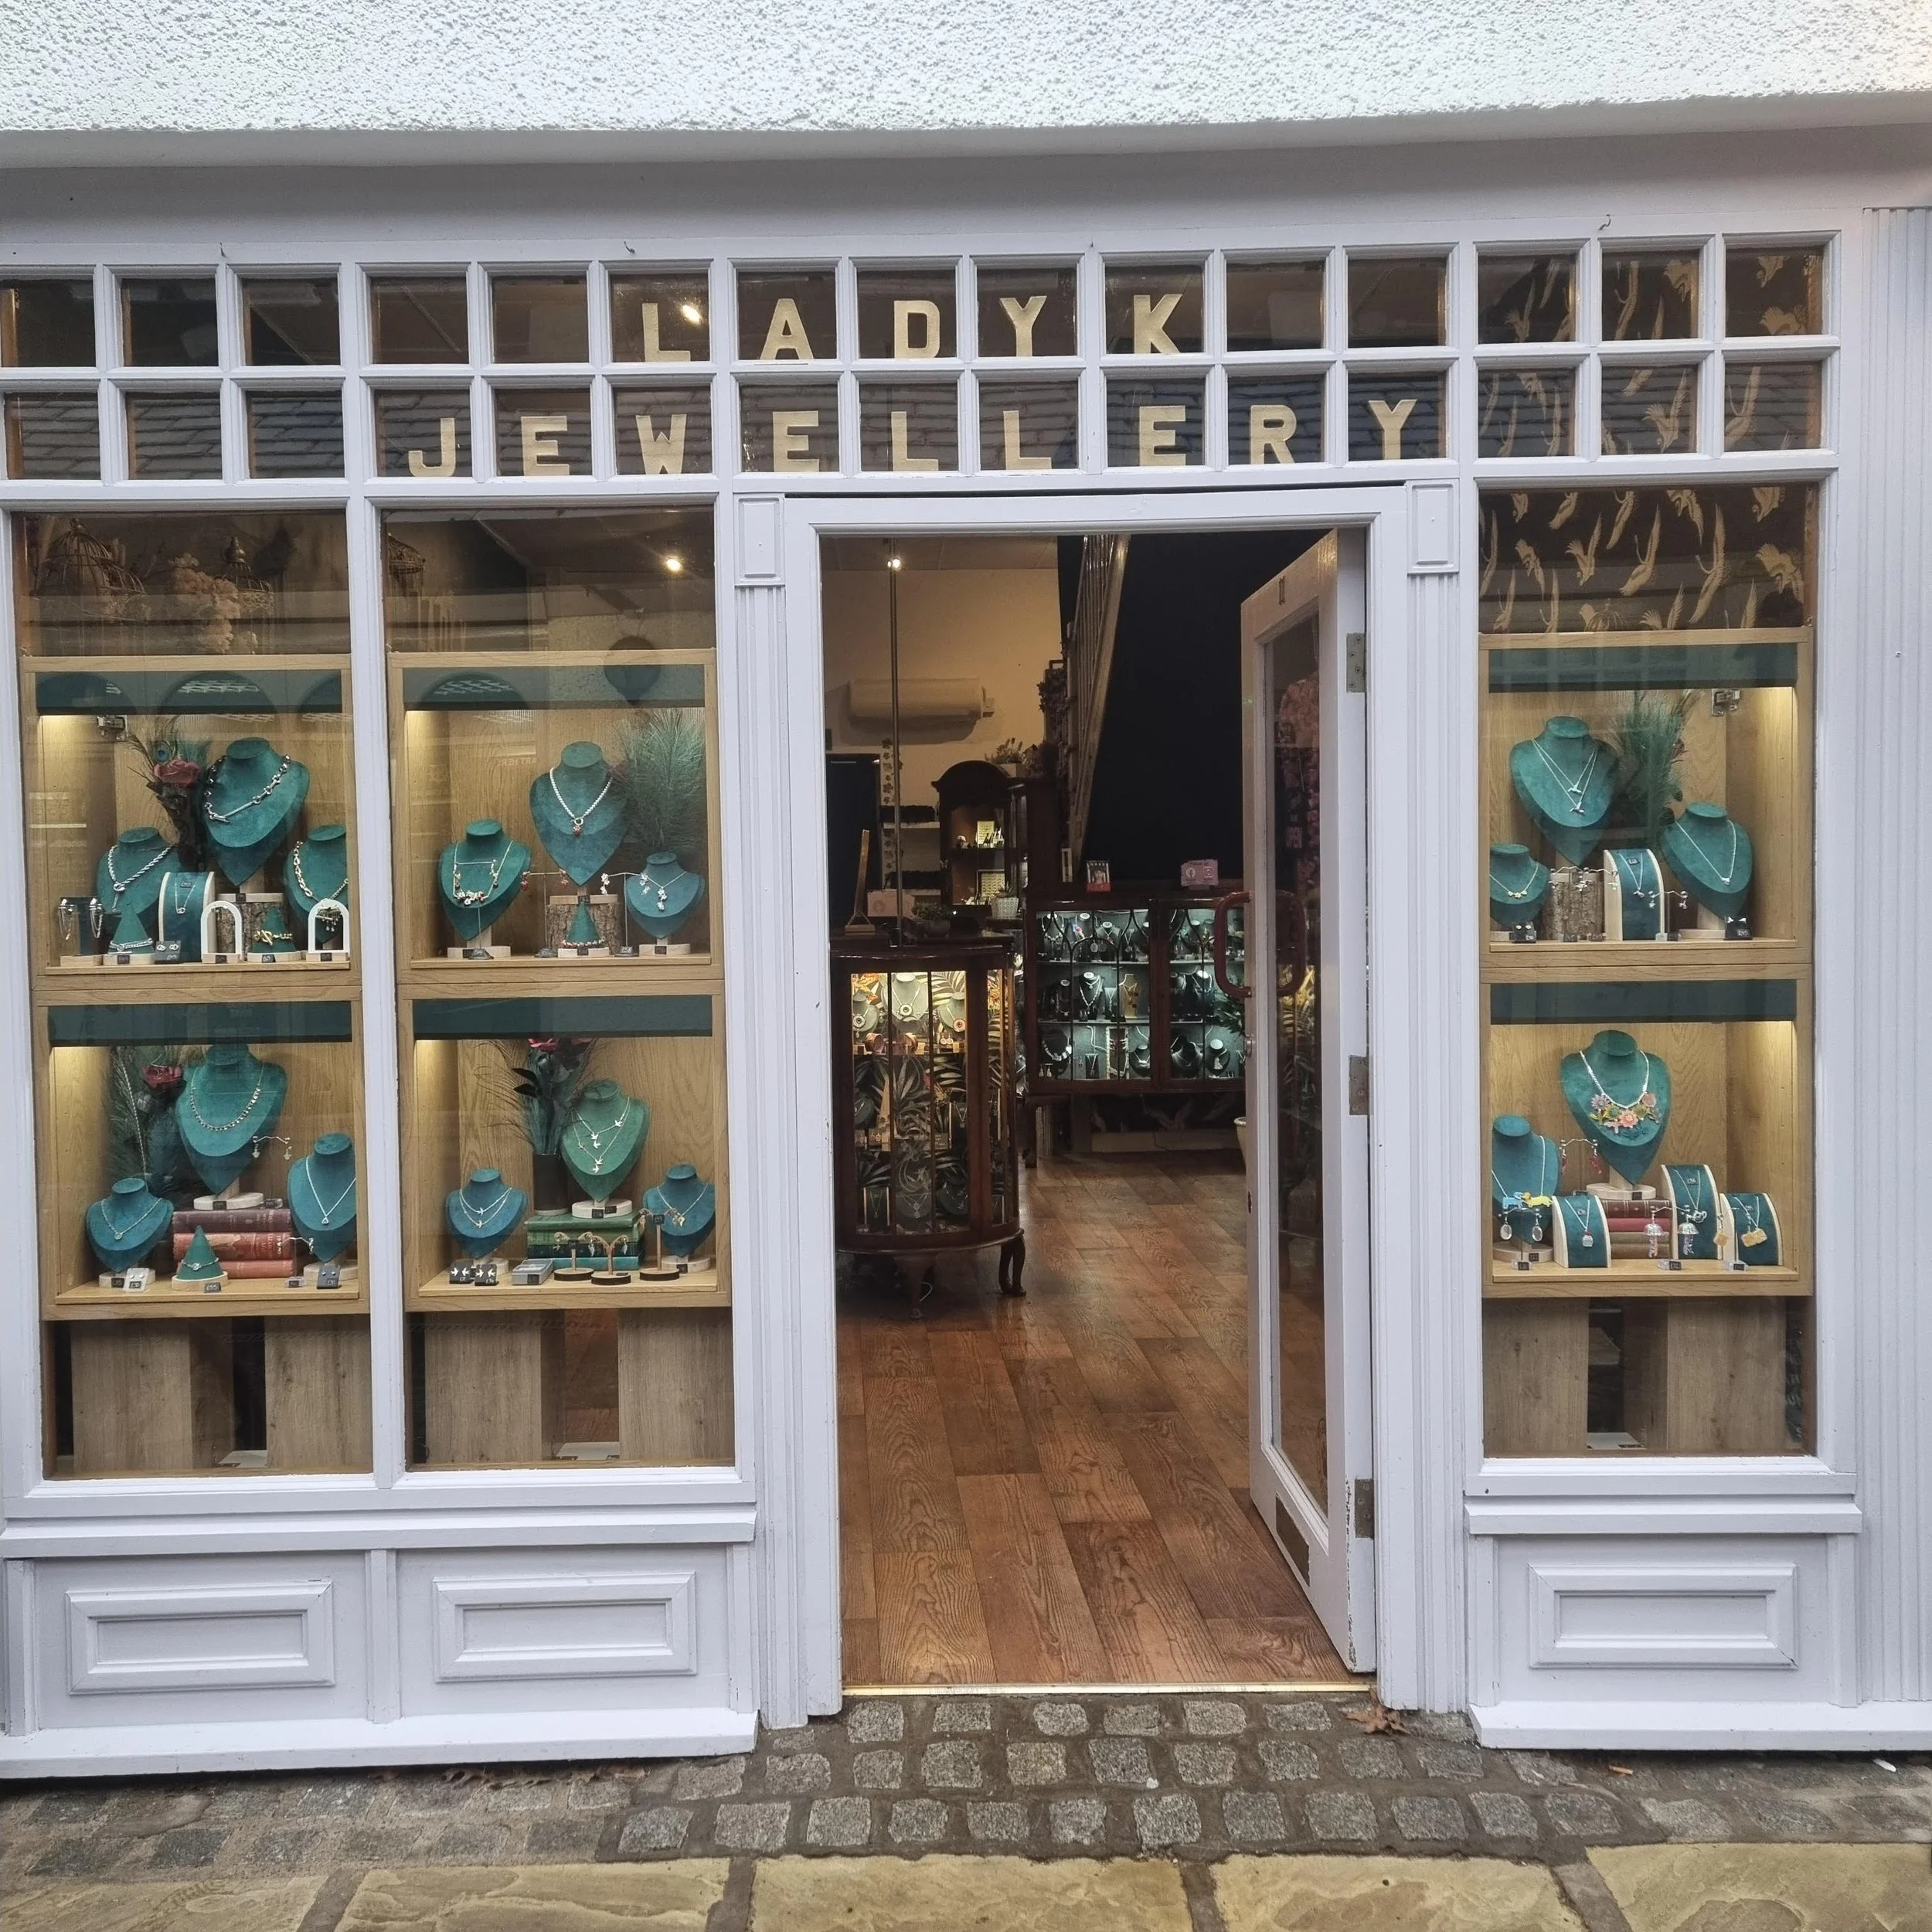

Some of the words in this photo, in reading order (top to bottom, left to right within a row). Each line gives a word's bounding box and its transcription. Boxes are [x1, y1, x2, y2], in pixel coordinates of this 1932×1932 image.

[642, 295, 1046, 362] LADY
[1132, 294, 1182, 354] K
[408, 400, 1417, 478] JEWELLERY
